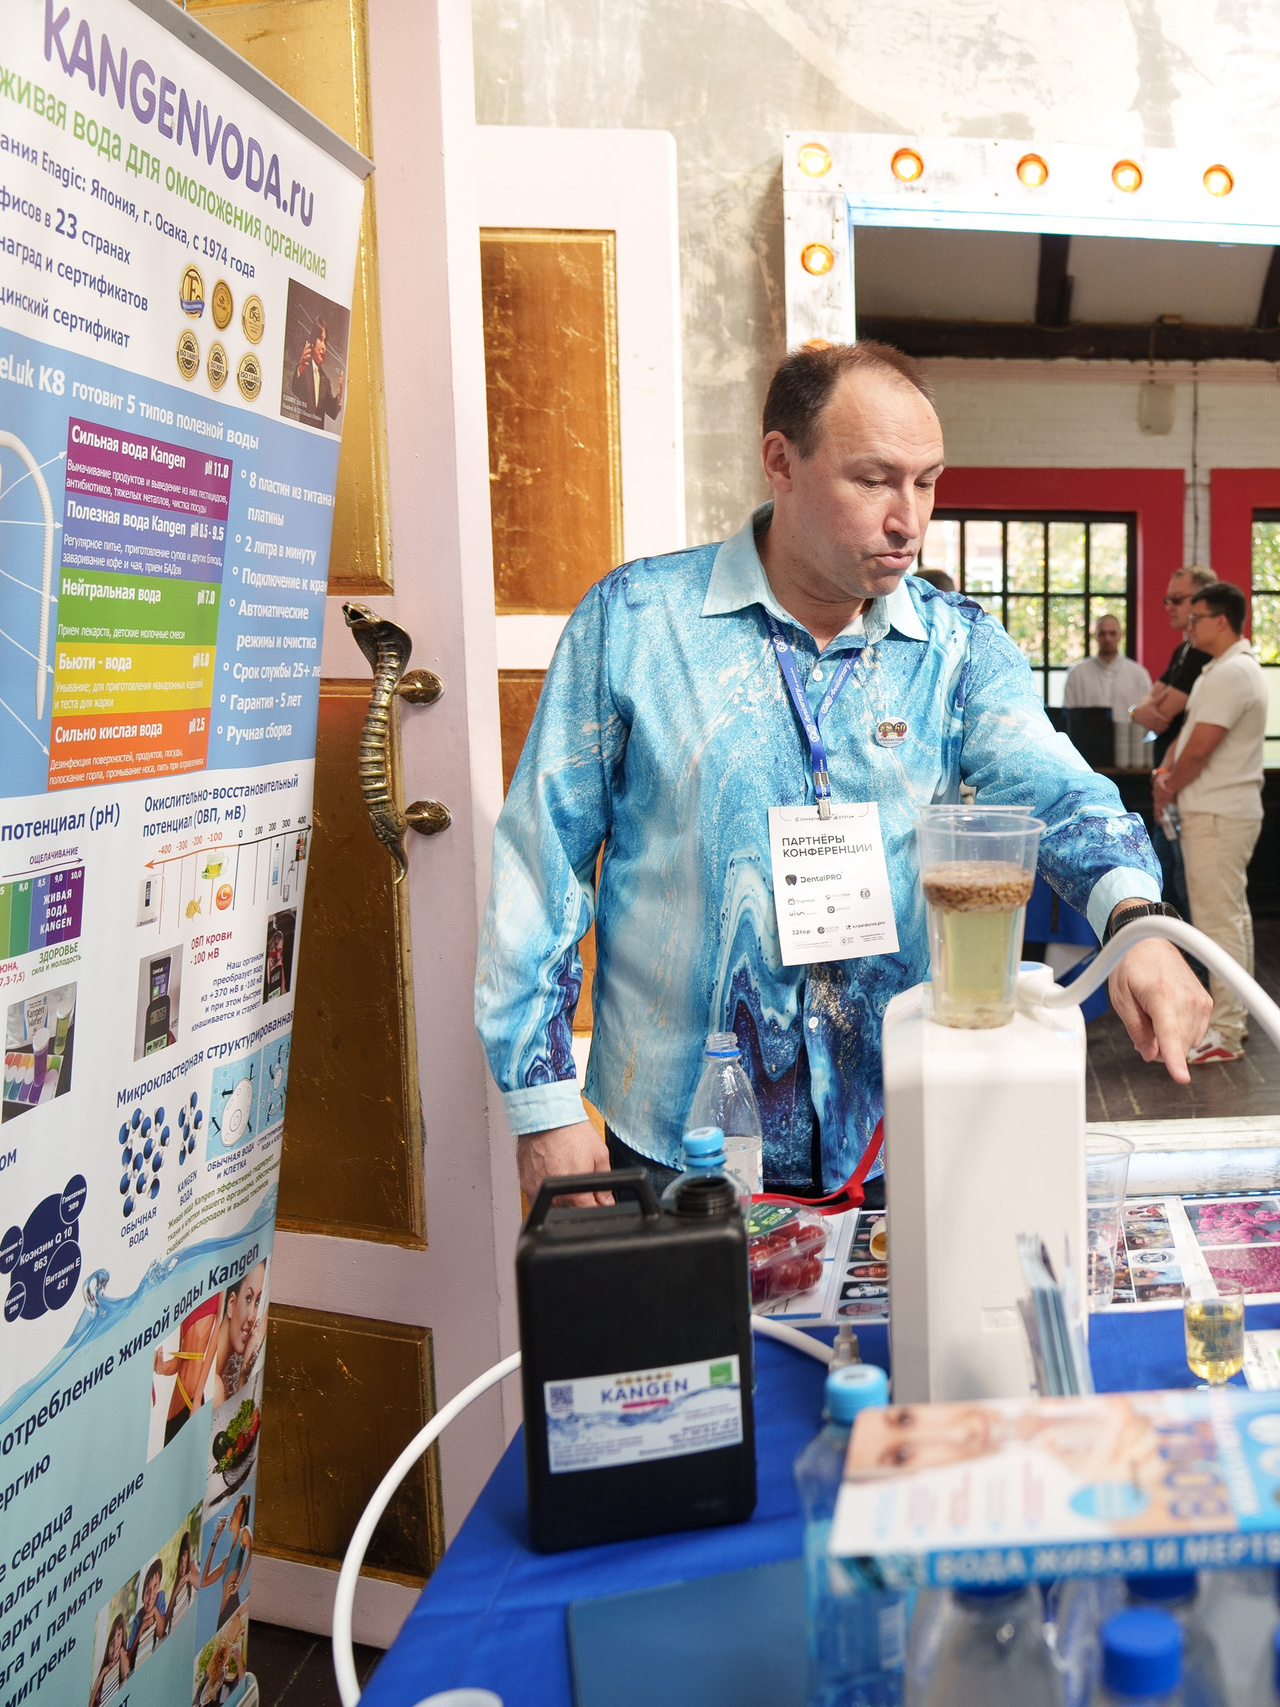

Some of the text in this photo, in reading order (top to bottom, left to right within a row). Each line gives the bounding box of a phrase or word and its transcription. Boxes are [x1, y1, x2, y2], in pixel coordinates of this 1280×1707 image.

[44, 0, 314, 227] KANGENVODA.ru
[0, 64, 327, 280] живая вода для омоложения организма
[1, 133, 255, 278] ания Enagic: Япония, г. Осака, с 1974 года
[44, 212, 51, 228] в
[55, 208, 78, 240] 23
[82, 229, 131, 265] странах
[45, 256, 53, 273] и
[57, 262, 148, 311] сертификатов
[53, 308, 130, 348] сертификат
[38, 364, 66, 396] K8
[72, 381, 124, 411] готовит
[126, 394, 136, 415] 5
[139, 401, 174, 426] типов
[176, 414, 223, 440] полезной
[226, 431, 259, 450] воды
[71, 425, 186, 469] Сильная вода Kangen
[67, 459, 111, 478] Вымачивание
[112, 469, 144, 487] продуктов
[204, 460, 229, 479] pH 11.0
[114, 487, 142, 501] тяжелых
[171, 500, 189, 511] чистка
[249, 472, 331, 507] 8 пластин из титана
[67, 500, 186, 537] Полезная вода Kangen
[248, 507, 284, 526] платины
[190, 523, 224, 541] pH 8.5 9.5
[63, 533, 170, 559] Регулярное приготовление
[244, 536, 317, 565] 2 литра в минуту
[62, 553, 122, 570] заваривание кофе
[242, 567, 308, 590] Подключение к
[62, 578, 161, 603] Нейтральная вода
[197, 590, 216, 606] pH 7.0
[238, 599, 309, 620] Автоматические
[57, 623, 169, 639] Прием лекарств, детские молочные
[236, 634, 317, 651] режимы и очистка
[58, 653, 132, 672] Бьюти вода
[200, 652, 210, 667] 6.0
[232, 662, 310, 683] Срок службы 25+
[229, 692, 302, 714] Гарантия 5 лет
[55, 722, 163, 744] Сильно кислая вода
[196, 717, 205, 732] 2.5
[226, 722, 292, 745] Ручная сборка
[144, 773, 299, 813] Окислительно-восстановительный
[1, 802, 120, 841] потенциал (pH)
[142, 804, 247, 838] потенциал (ОВП, мВ)
[206, 825, 263, 842] -100 0 100
[782, 834, 845, 847] ПАРТНЁРЫ
[29, 847, 79, 865] ОЩЕЛАЧИВАНИЕ
[783, 843, 873, 858] КОНФЕРЕНЦИИ
[18, 870, 82, 893] 8,0 8,5 9,0 10,0
[800, 873, 842, 883] DentalPRO
[43, 888, 72, 905] ЖИВАЯ
[46, 903, 67, 919] ВОДА
[39, 916, 72, 934] KANGEN
[190, 931, 233, 950] ОВП крови
[39, 942, 79, 963] ЗДОРОВЬЕ
[207, 947, 220, 960] мВ
[31, 966, 44, 976] сила
[226, 960, 241, 971] Наш
[212, 969, 252, 987] преобразует
[209, 988, 228, 1000] +370
[210, 998, 241, 1013] при этом
[116, 1010, 294, 1108] Микрокластерная структурированная
[206, 1151, 241, 1172] ОБЫЧНАЯ
[241, 1143, 255, 1157] ВОДА
[223, 1160, 247, 1177] КЛЕТКА
[177, 1170, 198, 1194] KANGEN
[179, 1188, 193, 1207] ВОДА
[120, 1206, 157, 1238] ОБЫЧНАЯ
[19, 1226, 73, 1266] Коэнзим Q 10
[129, 1227, 149, 1248] ВОДА
[33, 1256, 48, 1272] 863
[45, 1262, 74, 1286] Витамин
[57, 1277, 69, 1291] 431
[118, 1305, 170, 1366] живой
[173, 1284, 203, 1322] воды
[208, 1242, 259, 1291] Kangen
[601, 1377, 689, 1405] KANGEN
[70, 1472, 144, 1557] давление
[11, 1504, 73, 1570] сердца
[933, 1551, 1026, 1585] ВОДА
[1032, 1542, 1149, 1575] ЖИВАЯ
[1152, 1538, 1180, 1568] И
[0, 1521, 124, 1652] аркт и инсульт
[30, 1635, 40, 1658] и
[46, 1577, 103, 1643] память
